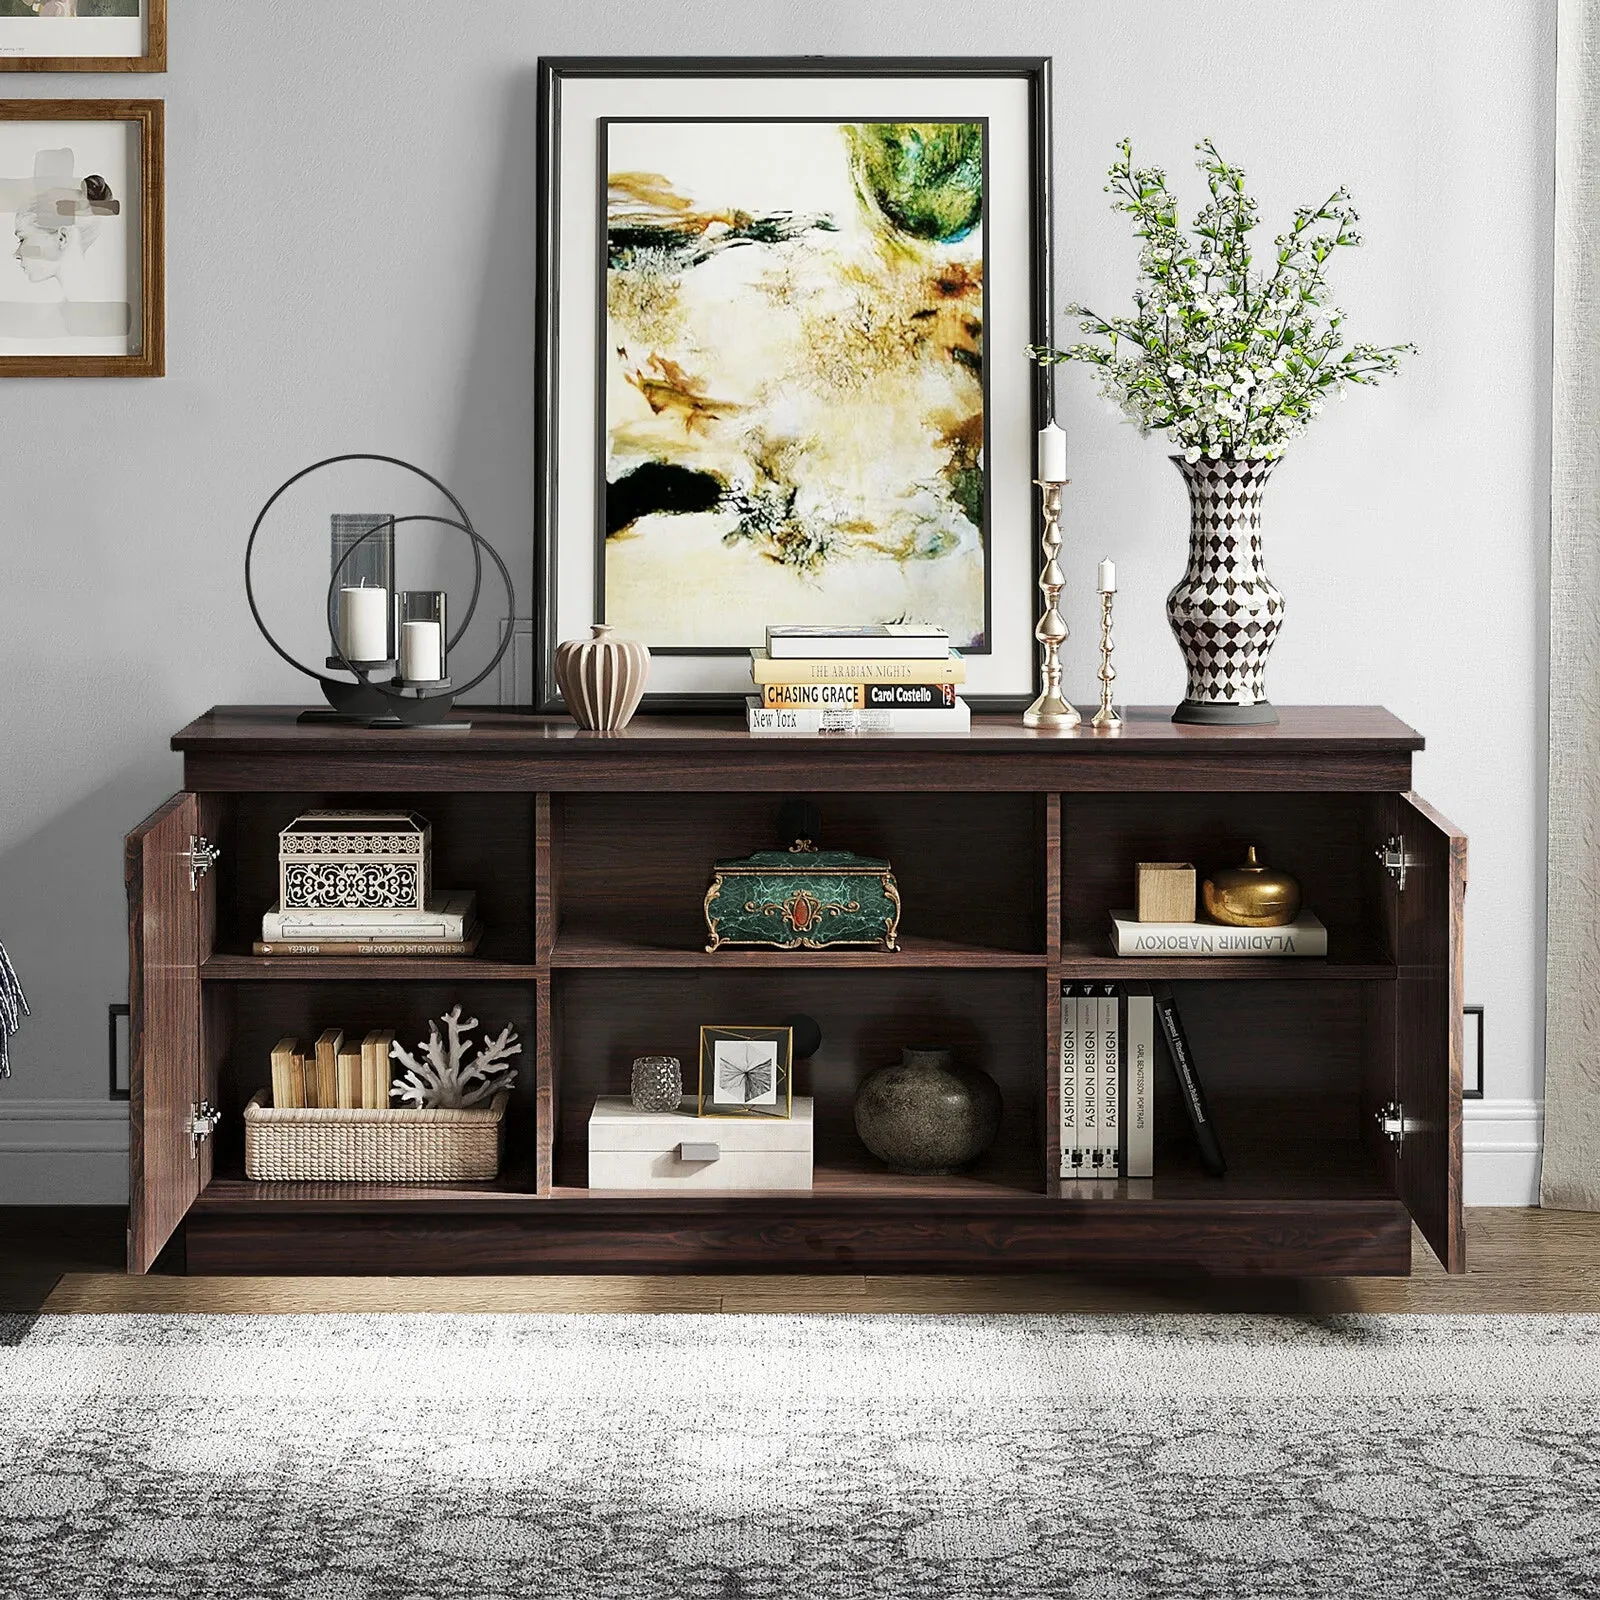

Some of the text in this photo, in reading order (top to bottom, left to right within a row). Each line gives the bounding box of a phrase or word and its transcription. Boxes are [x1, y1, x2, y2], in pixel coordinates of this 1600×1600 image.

[811, 665, 912, 678] THE ARABIAN NIGHTS
[768, 686, 859, 703] CHASING GRACE
[871, 687, 894, 702] Carol
[896, 686, 932, 702] Costello
[753, 710, 797, 728] New York
[1135, 935, 1296, 952] VLADIMIR NABOKOV
[1064, 1030, 1075, 1073] DESIGN
[1105, 1030, 1117, 1073] DESIGN
[1136, 1043, 1145, 1059] CARL
[1085, 1030, 1096, 1128] FASHION DESIGN
[1064, 1077, 1075, 1128] FASHION
[1105, 1077, 1117, 1128] FASHION
[1136, 1097, 1145, 1130] PORTRAITS
